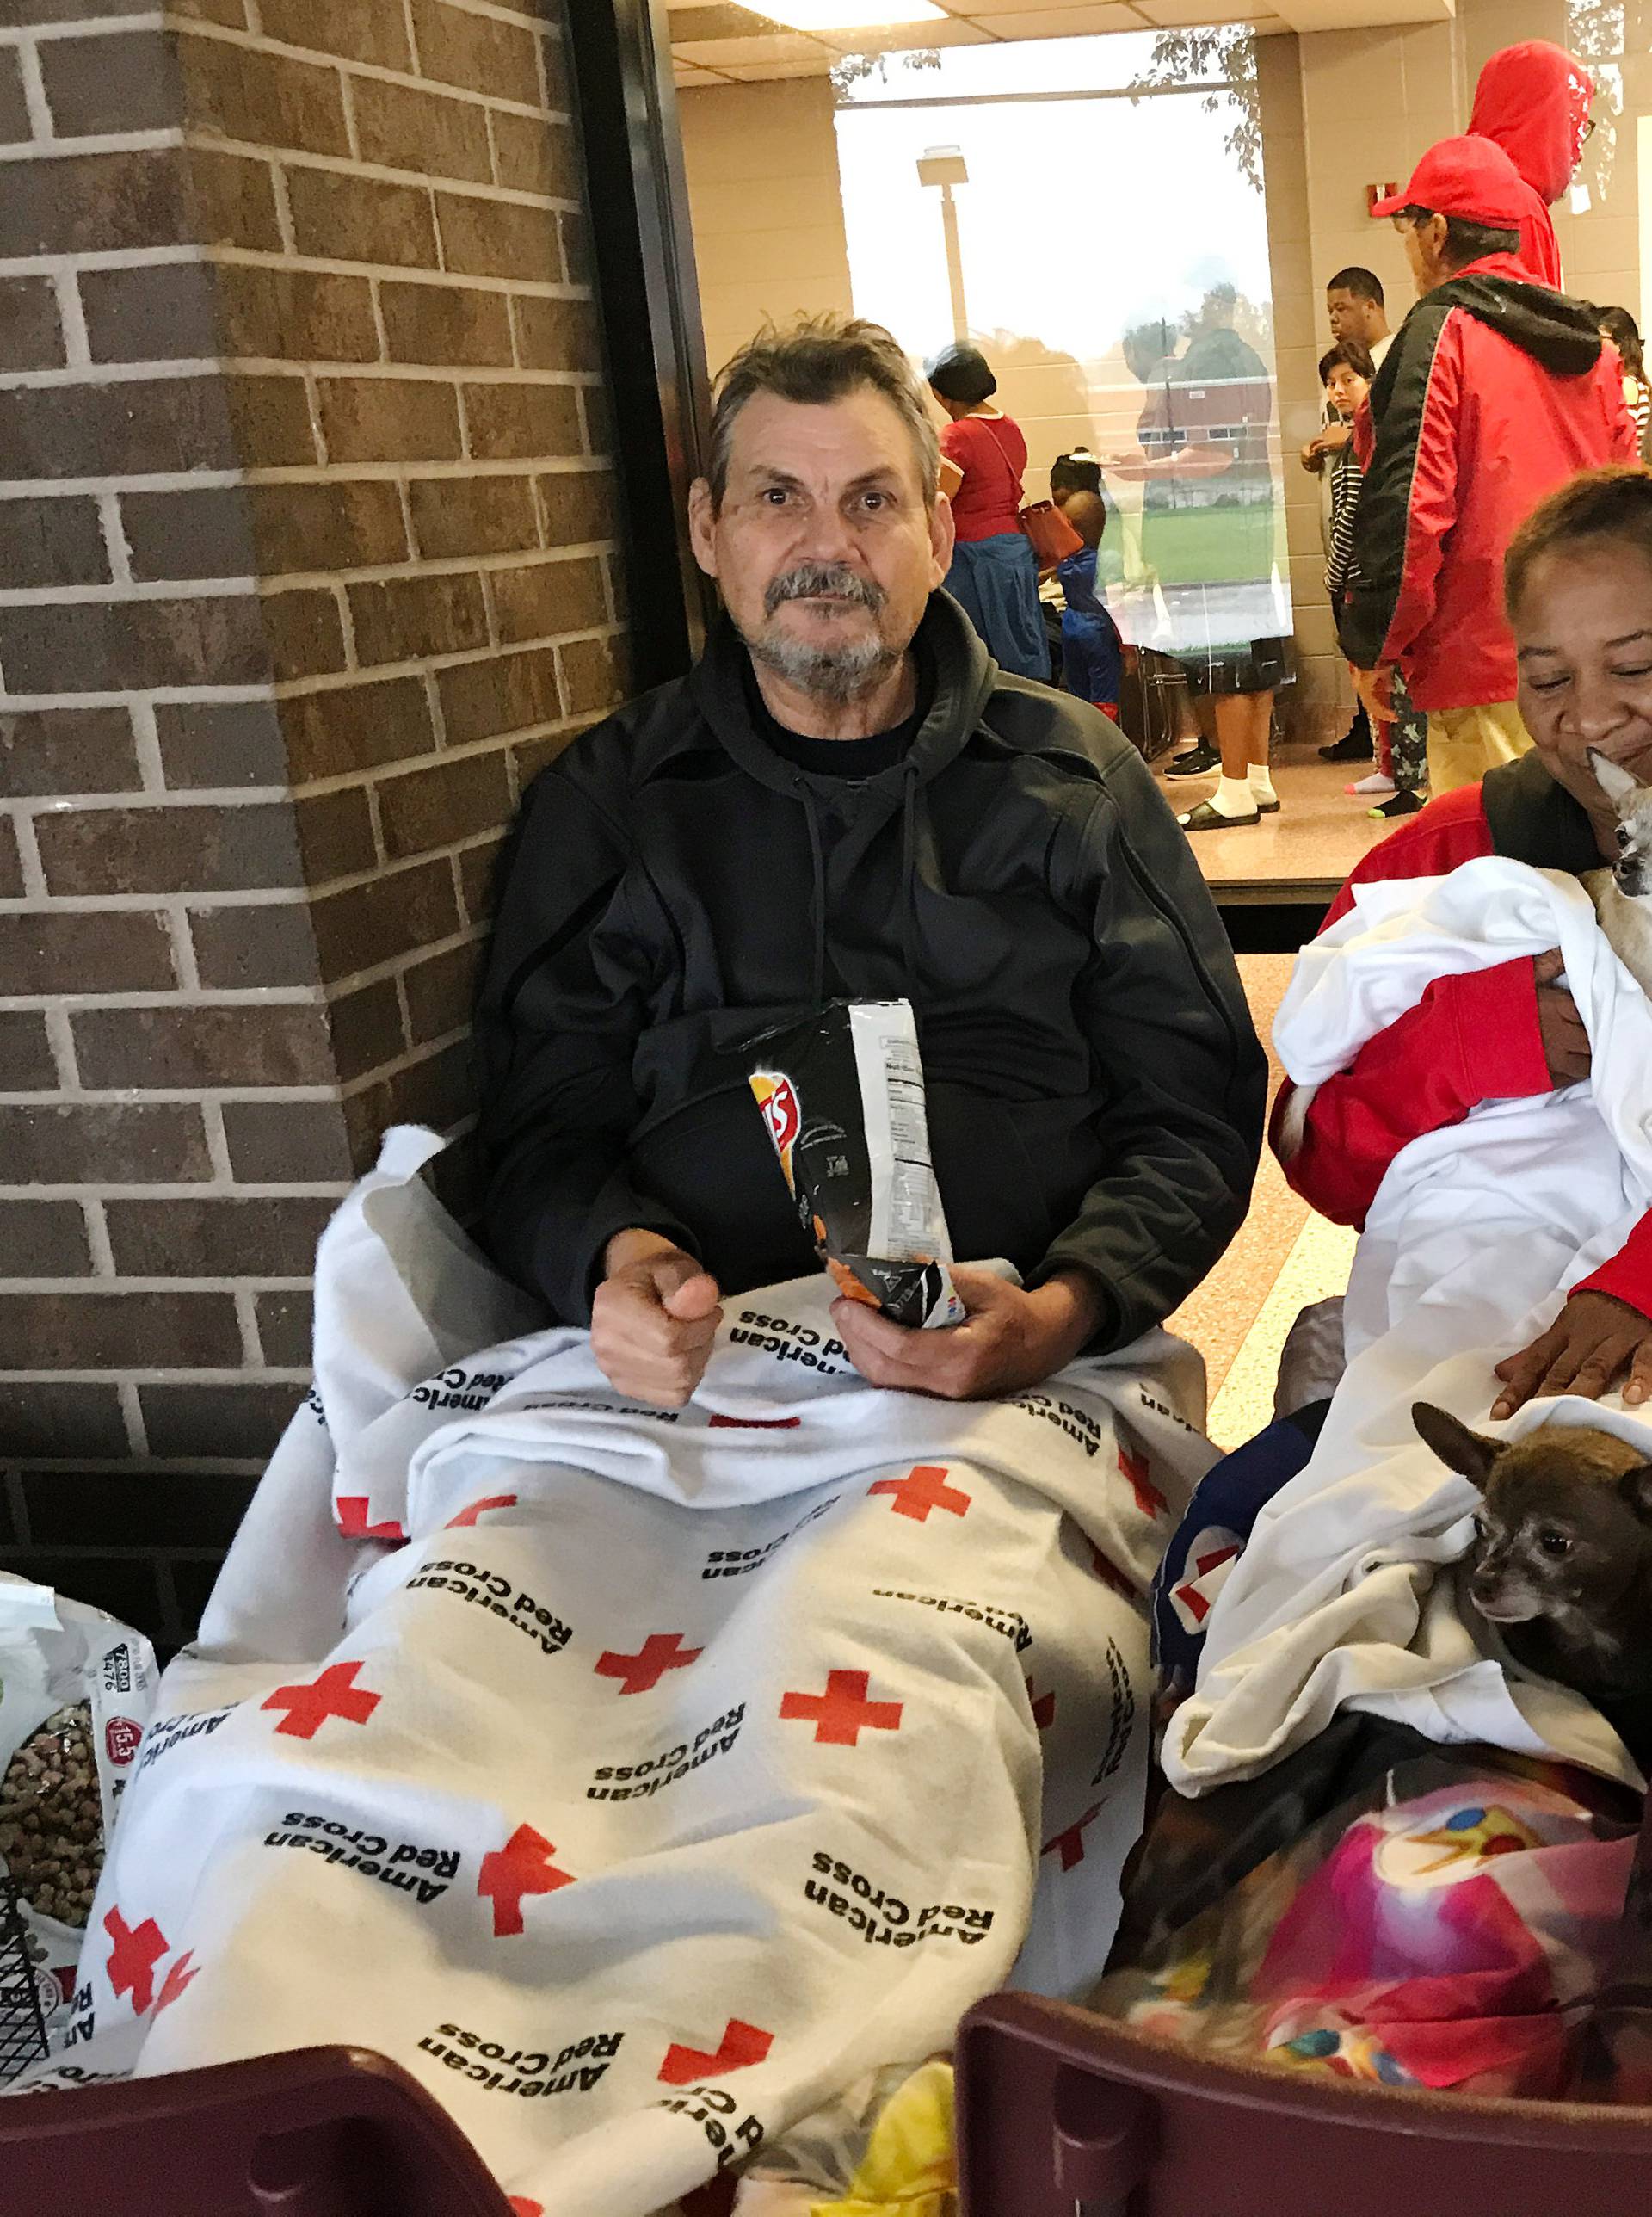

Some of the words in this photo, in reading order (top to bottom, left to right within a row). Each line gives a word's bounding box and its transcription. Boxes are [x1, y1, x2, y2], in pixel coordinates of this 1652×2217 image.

[730, 1327, 847, 1374] merican
[739, 1311, 820, 1346] Cross
[412, 1386, 491, 1411] meric
[1059, 1401, 1101, 1440] Red
[419, 1560, 512, 1597] Cross
[406, 1576, 563, 1654] American
[514, 1593, 573, 1646] Red
[142, 1713, 231, 1769] Americ
[693, 1702, 746, 1753] Red
[587, 1727, 740, 1800] American
[595, 1744, 688, 1781] Cross
[281, 1812, 388, 1856] Cross
[264, 1831, 449, 1904] American
[388, 1843, 461, 1879] Red
[804, 1879, 988, 1948] American
[812, 1852, 910, 1926] Cross
[917, 1905, 995, 1930] Red
[418, 2037, 611, 2097] American
[435, 2022, 550, 2075] Cross
[550, 2032, 626, 2075] Red
